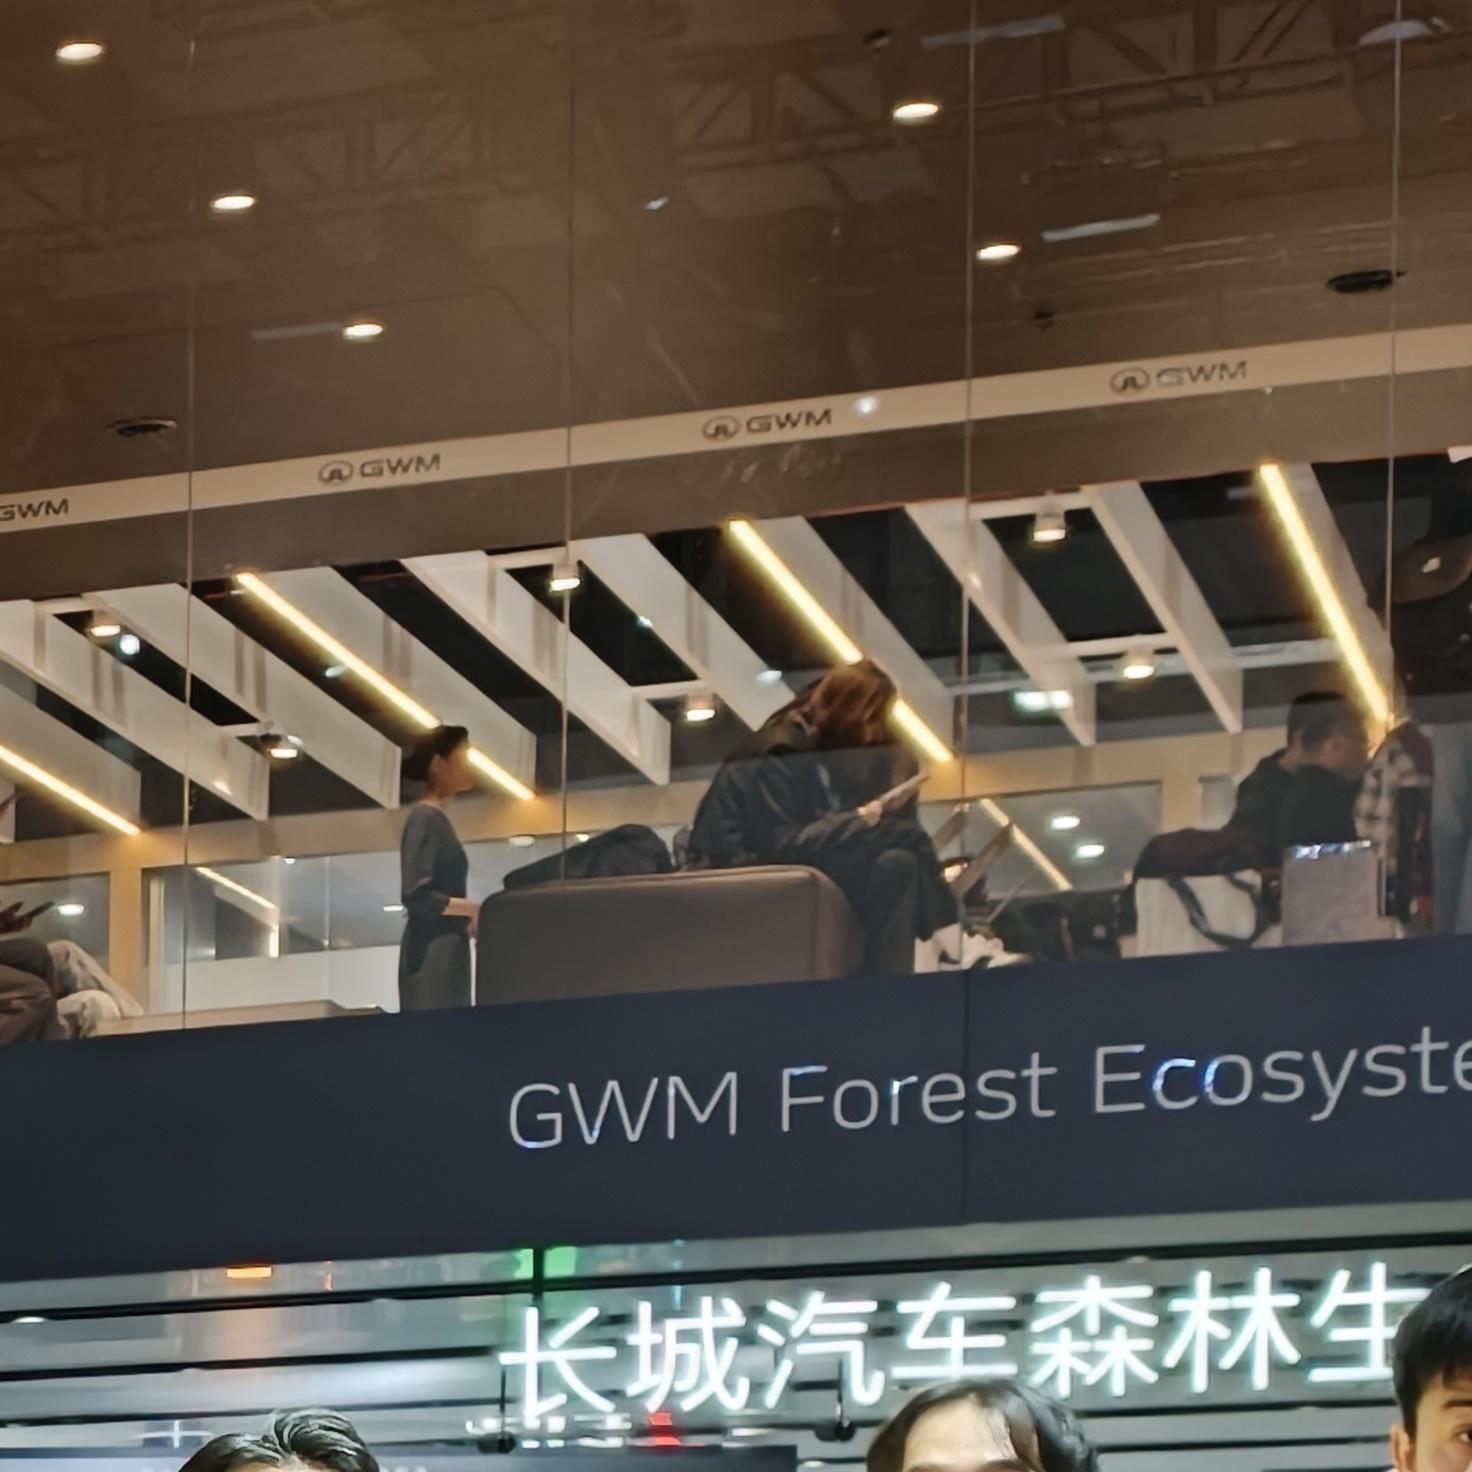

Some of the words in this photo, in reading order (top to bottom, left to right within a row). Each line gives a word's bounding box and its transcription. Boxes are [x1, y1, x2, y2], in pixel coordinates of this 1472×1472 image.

[1156, 361, 1248, 386] GWM
[746, 409, 832, 432] GWM
[359, 454, 441, 478] GWM
[509, 1070, 738, 1149] GWM
[781, 1052, 1059, 1132] Forest
[499, 1262, 1432, 1418] 长城汽车森林生
